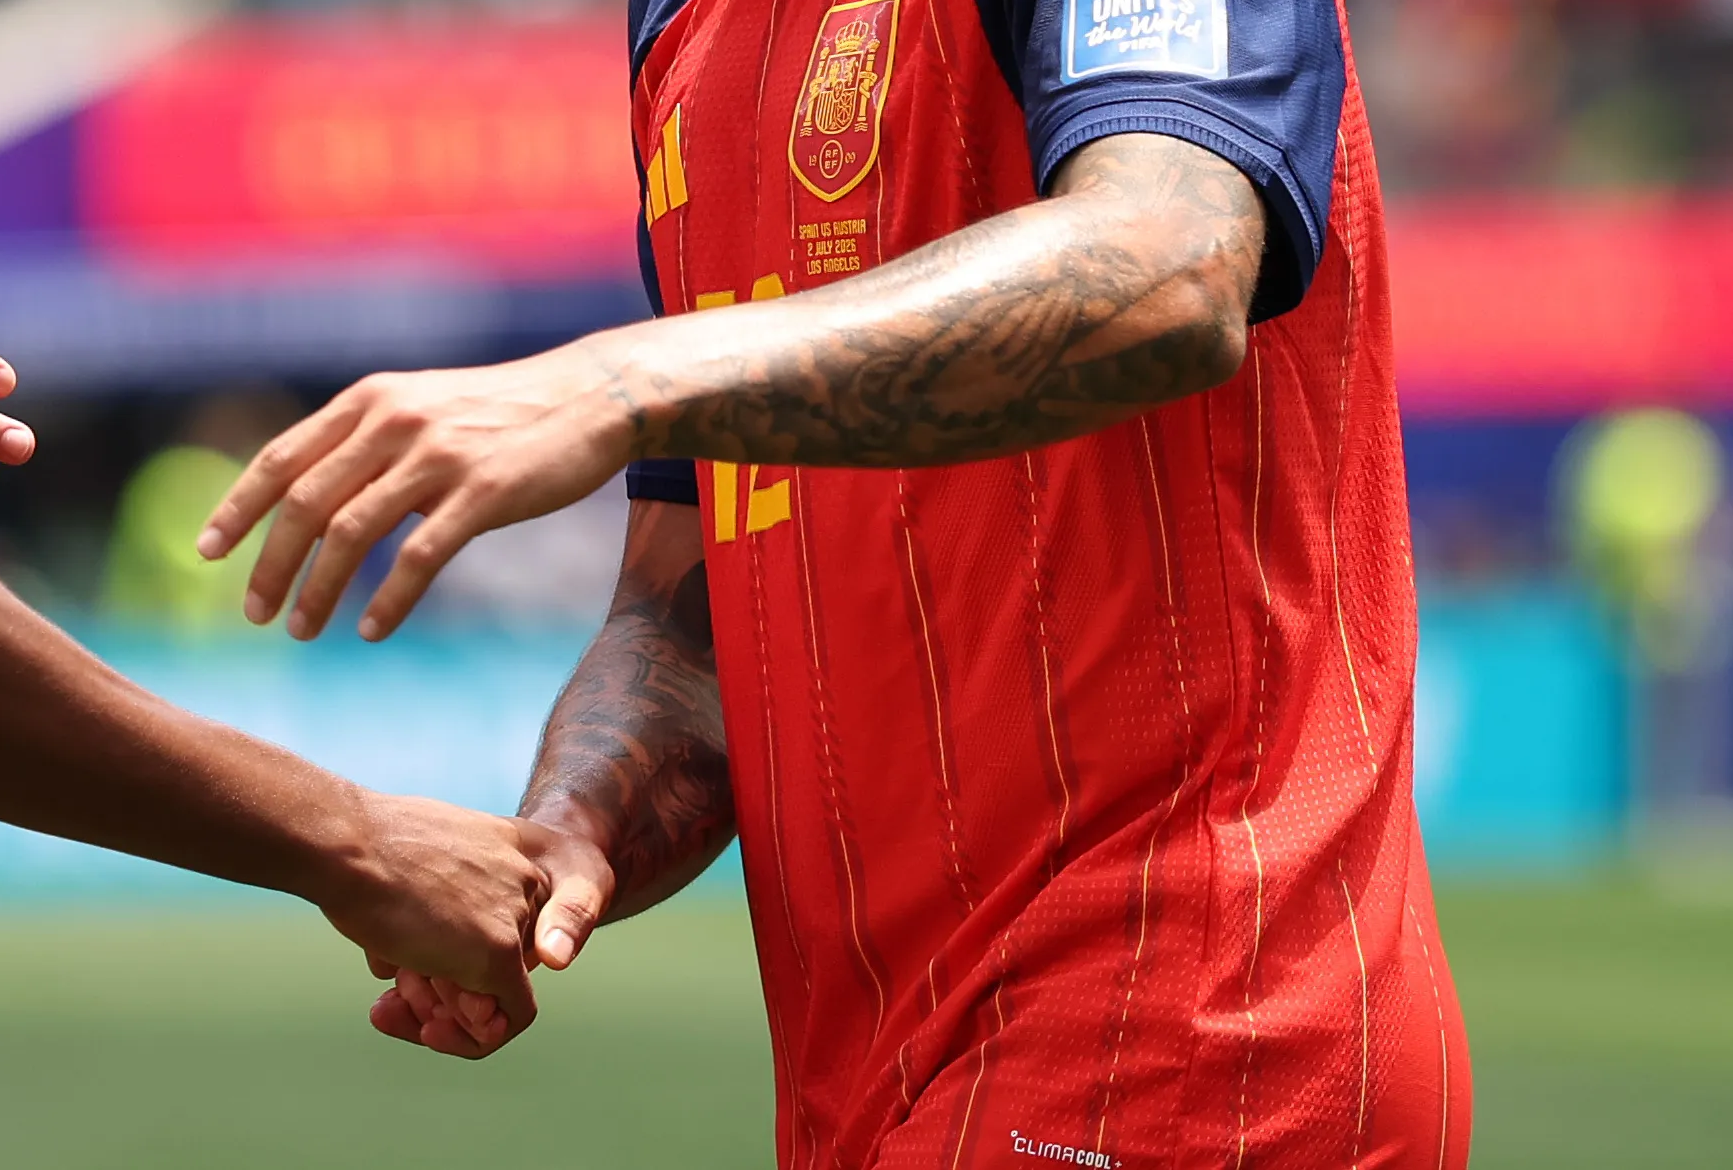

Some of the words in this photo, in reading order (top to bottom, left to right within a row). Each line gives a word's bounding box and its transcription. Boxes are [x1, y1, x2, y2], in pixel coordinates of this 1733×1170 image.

[1084, 21, 1128, 47] the
[1131, 11, 1202, 43] World
[798, 223, 819, 240] SPAIN
[832, 218, 867, 236] AUSTRIA
[807, 242, 813, 256] 2
[814, 241, 833, 256] JULY
[835, 238, 857, 254] 2026
[806, 259, 822, 276] LOS
[823, 256, 861, 273] ANGELES
